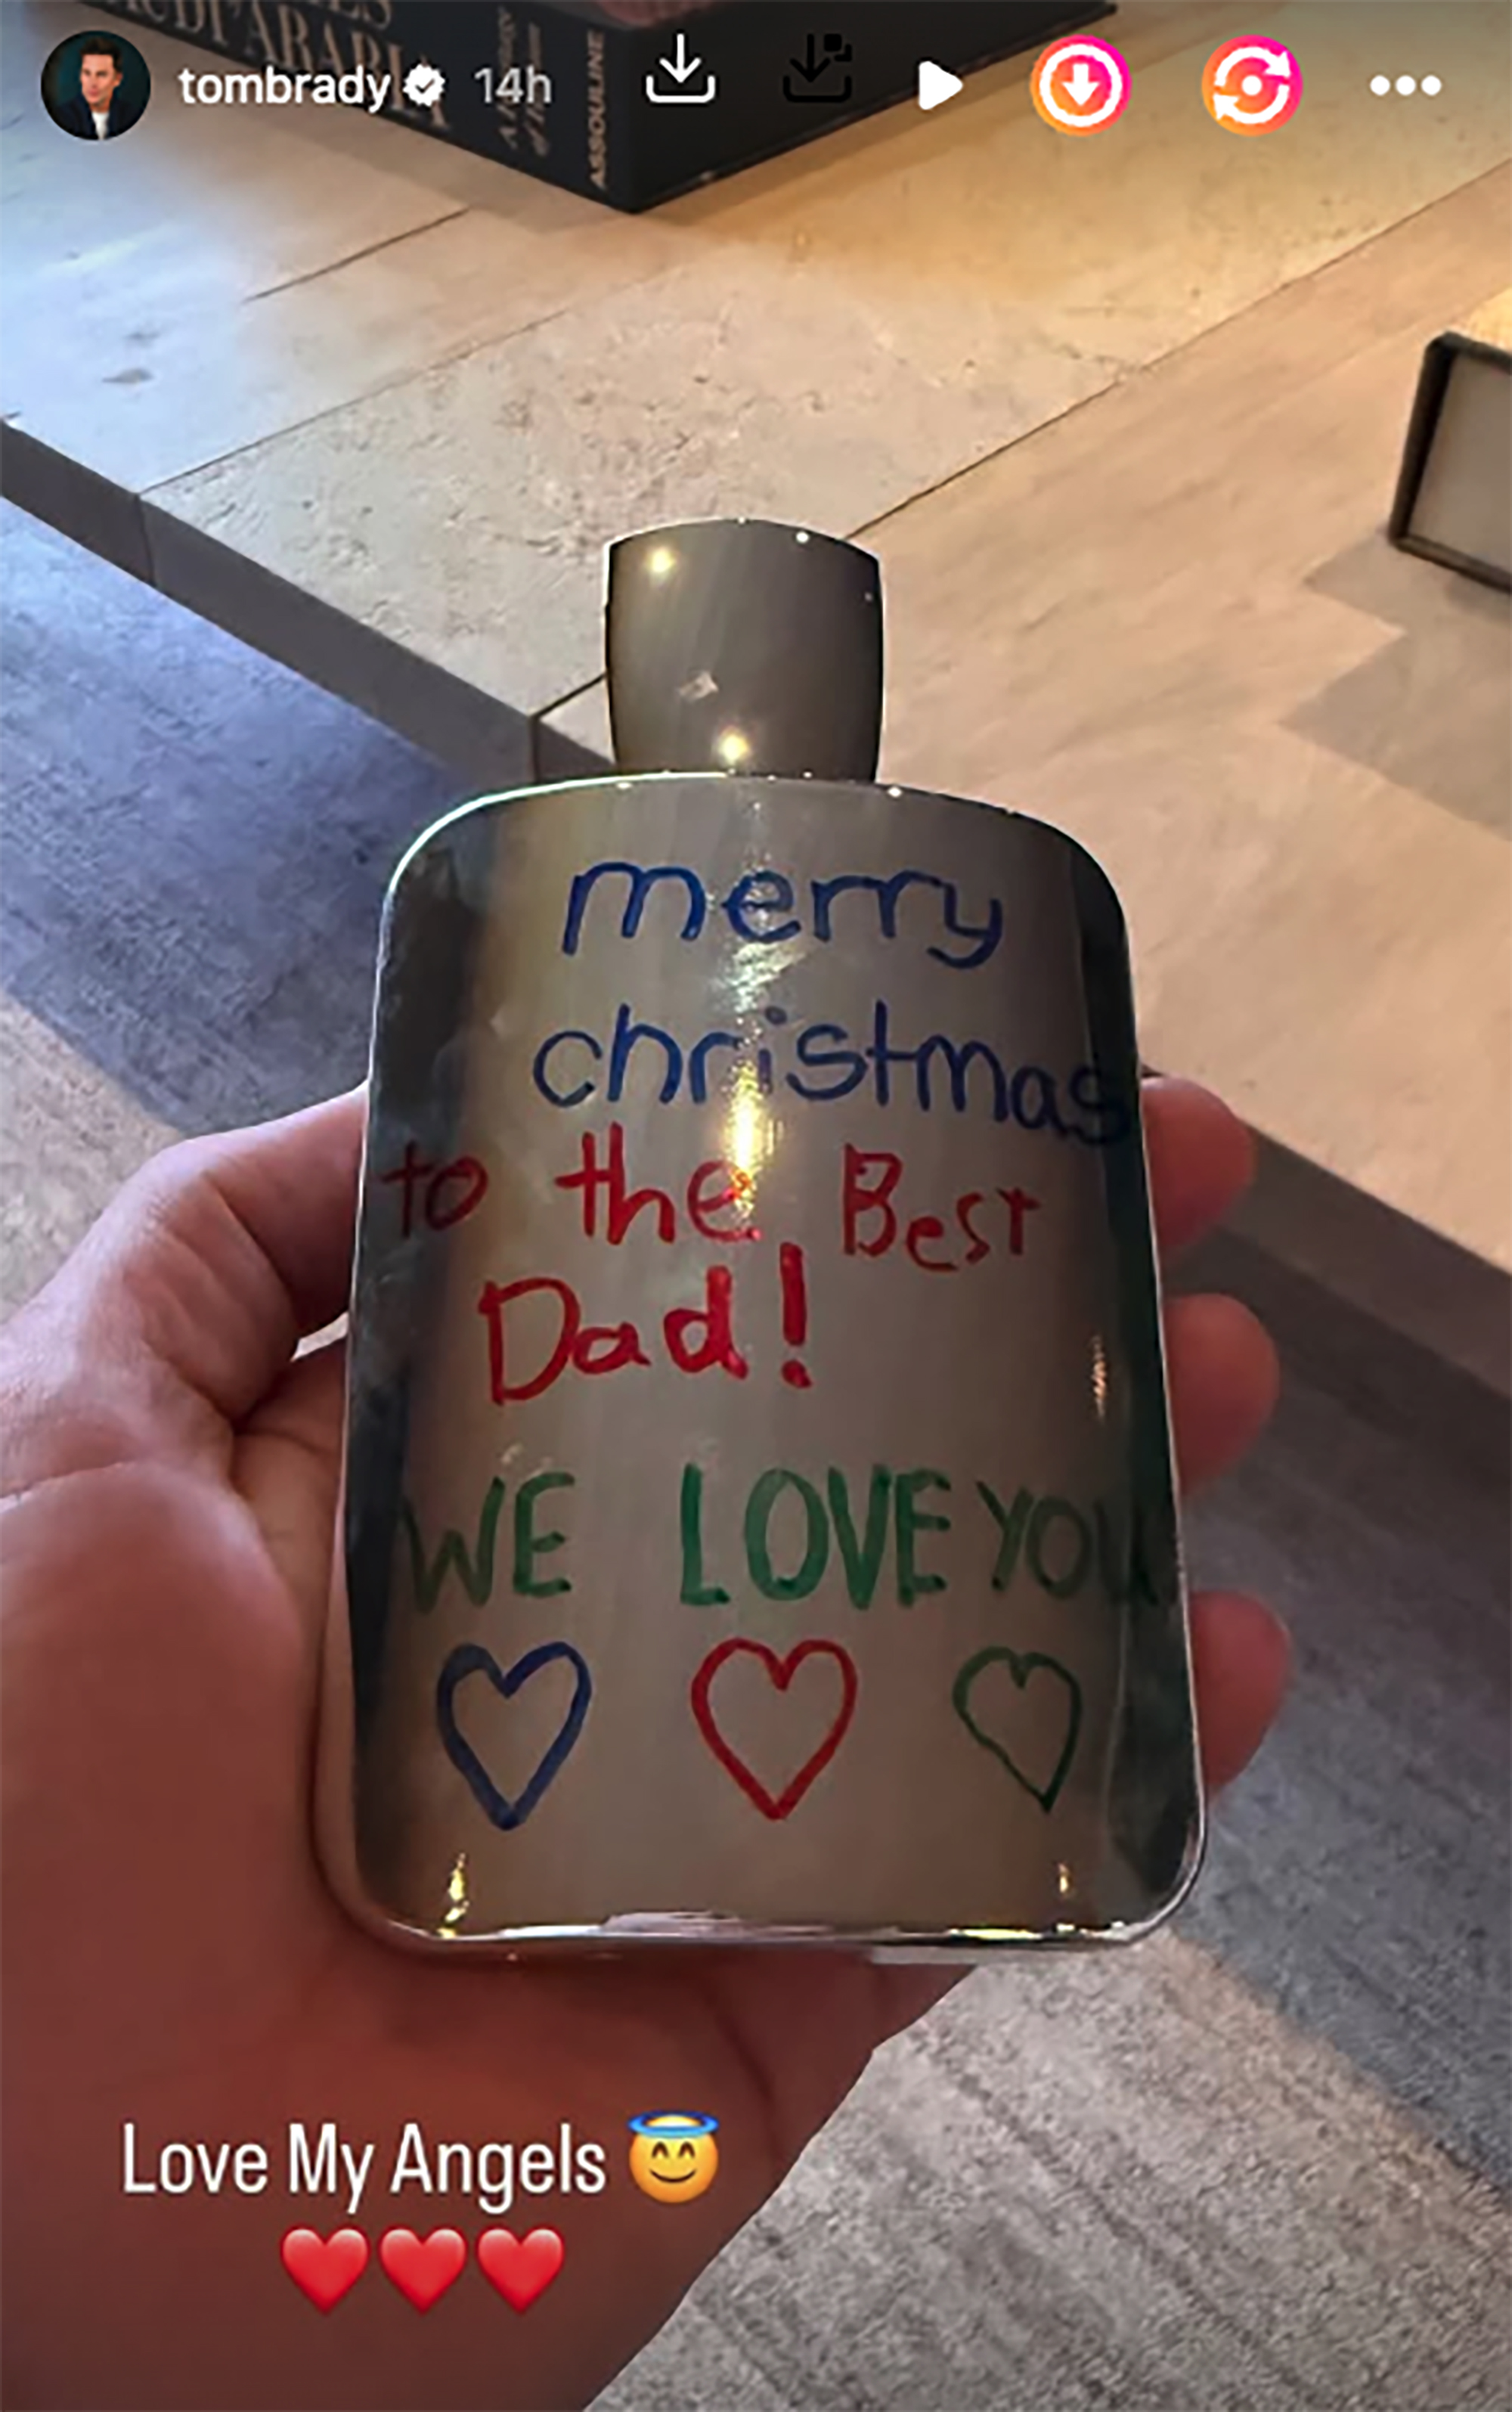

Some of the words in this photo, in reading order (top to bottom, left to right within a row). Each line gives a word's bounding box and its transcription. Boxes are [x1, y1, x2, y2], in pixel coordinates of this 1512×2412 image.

[586, 29, 606, 191] ASSOULINE
[562, 860, 1003, 970] merry
[533, 999, 1132, 1146] christmas
[380, 1134, 488, 1240] to
[555, 1122, 764, 1246] the
[841, 1143, 1042, 1271] Best
[478, 1242, 812, 1406] Dad!
[398, 1471, 575, 1614] WE
[680, 1464, 952, 1610] LOVE
[975, 1480, 1160, 1606] YOU
